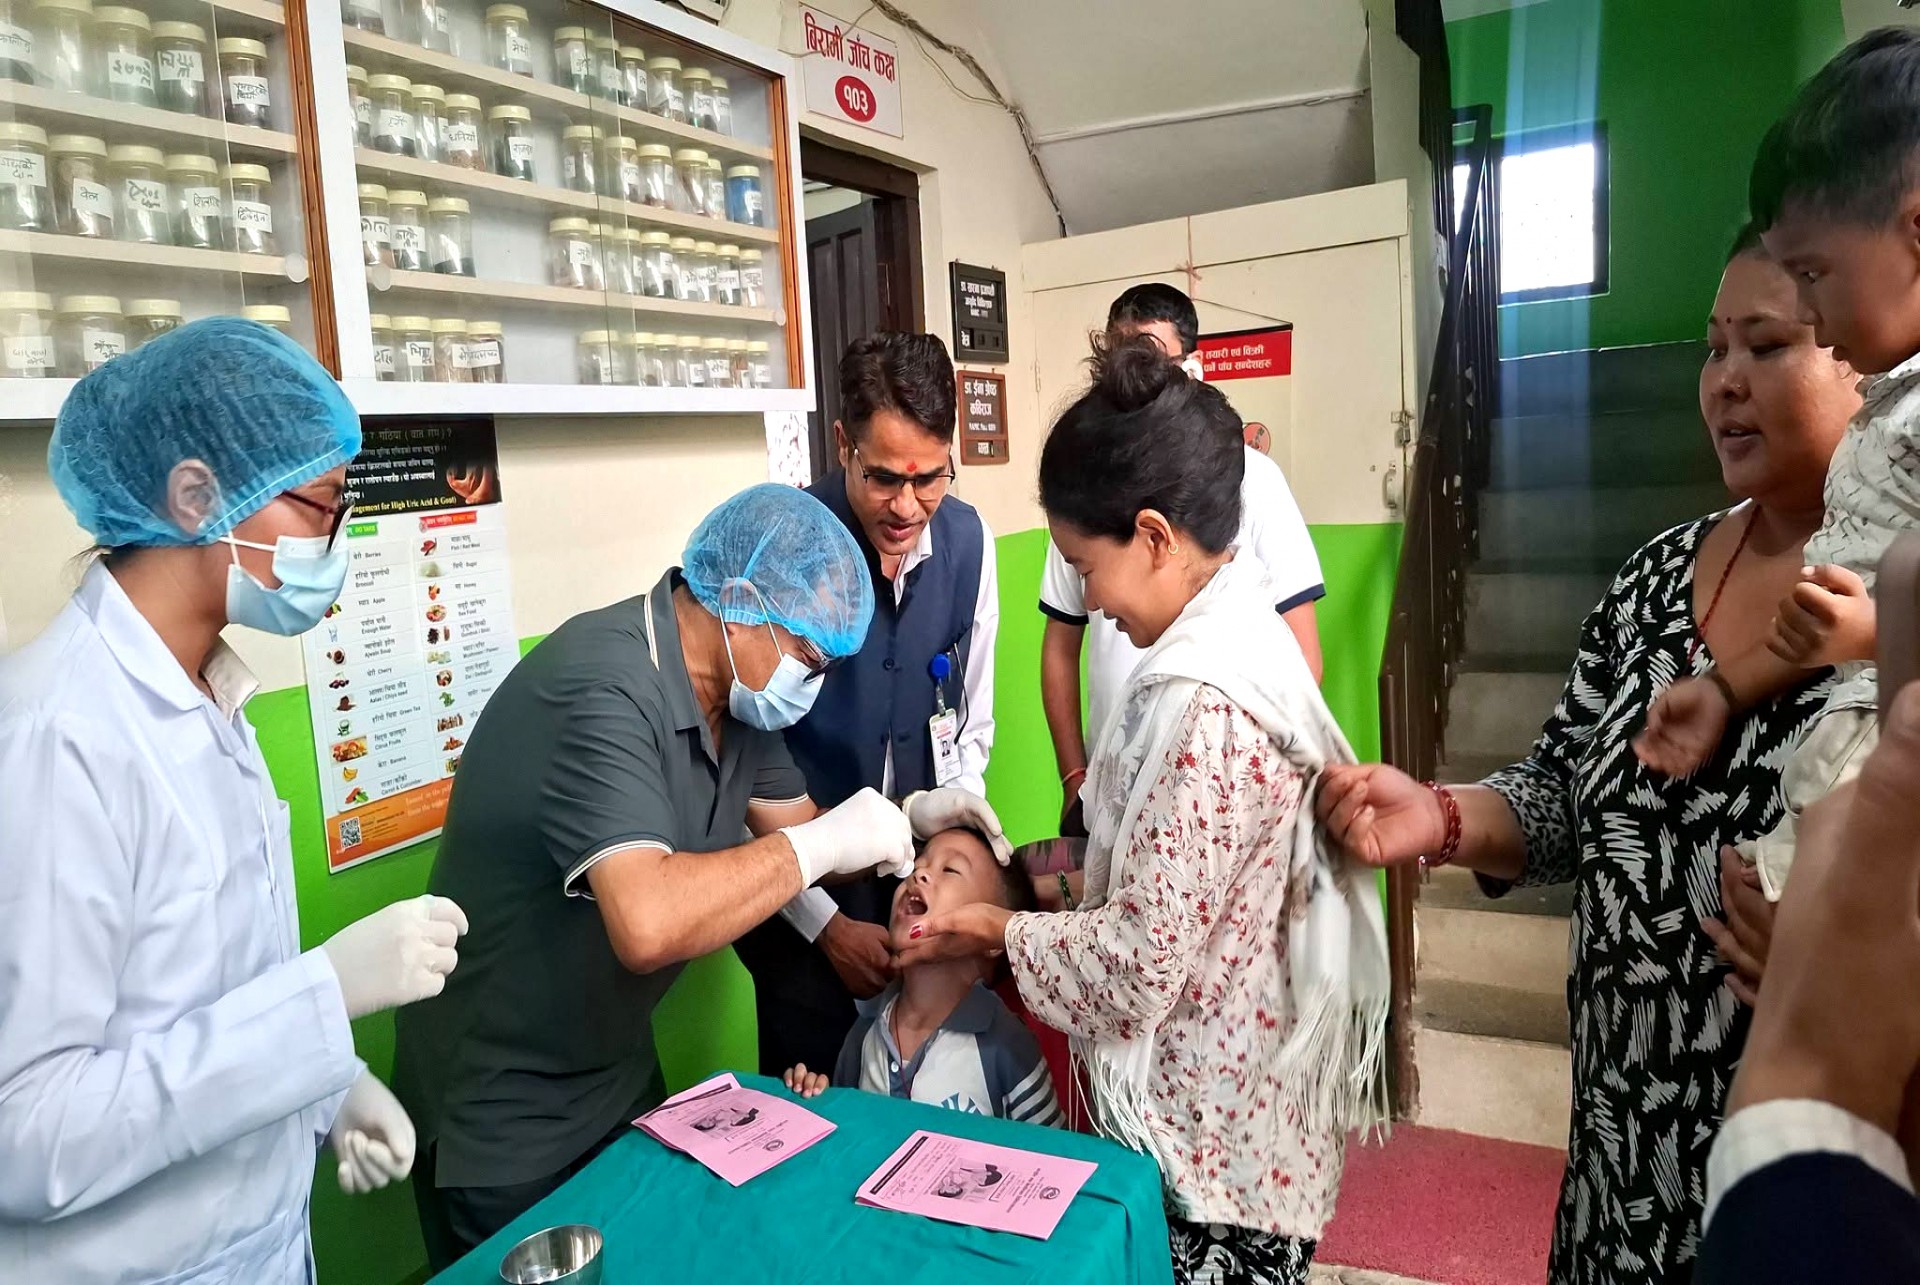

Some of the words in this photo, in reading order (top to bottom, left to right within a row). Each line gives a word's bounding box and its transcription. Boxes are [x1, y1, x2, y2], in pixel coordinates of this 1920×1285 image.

[804, 12, 844, 62] बिरामी
[873, 49, 896, 83] कक्ष
[844, 84, 868, 116] १०३
[1206, 348, 1228, 359] तयारी
[381, 502, 390, 510] for
[391, 501, 405, 511] High
[406, 500, 419, 508] Uric
[390, 756, 406, 764] Banana
